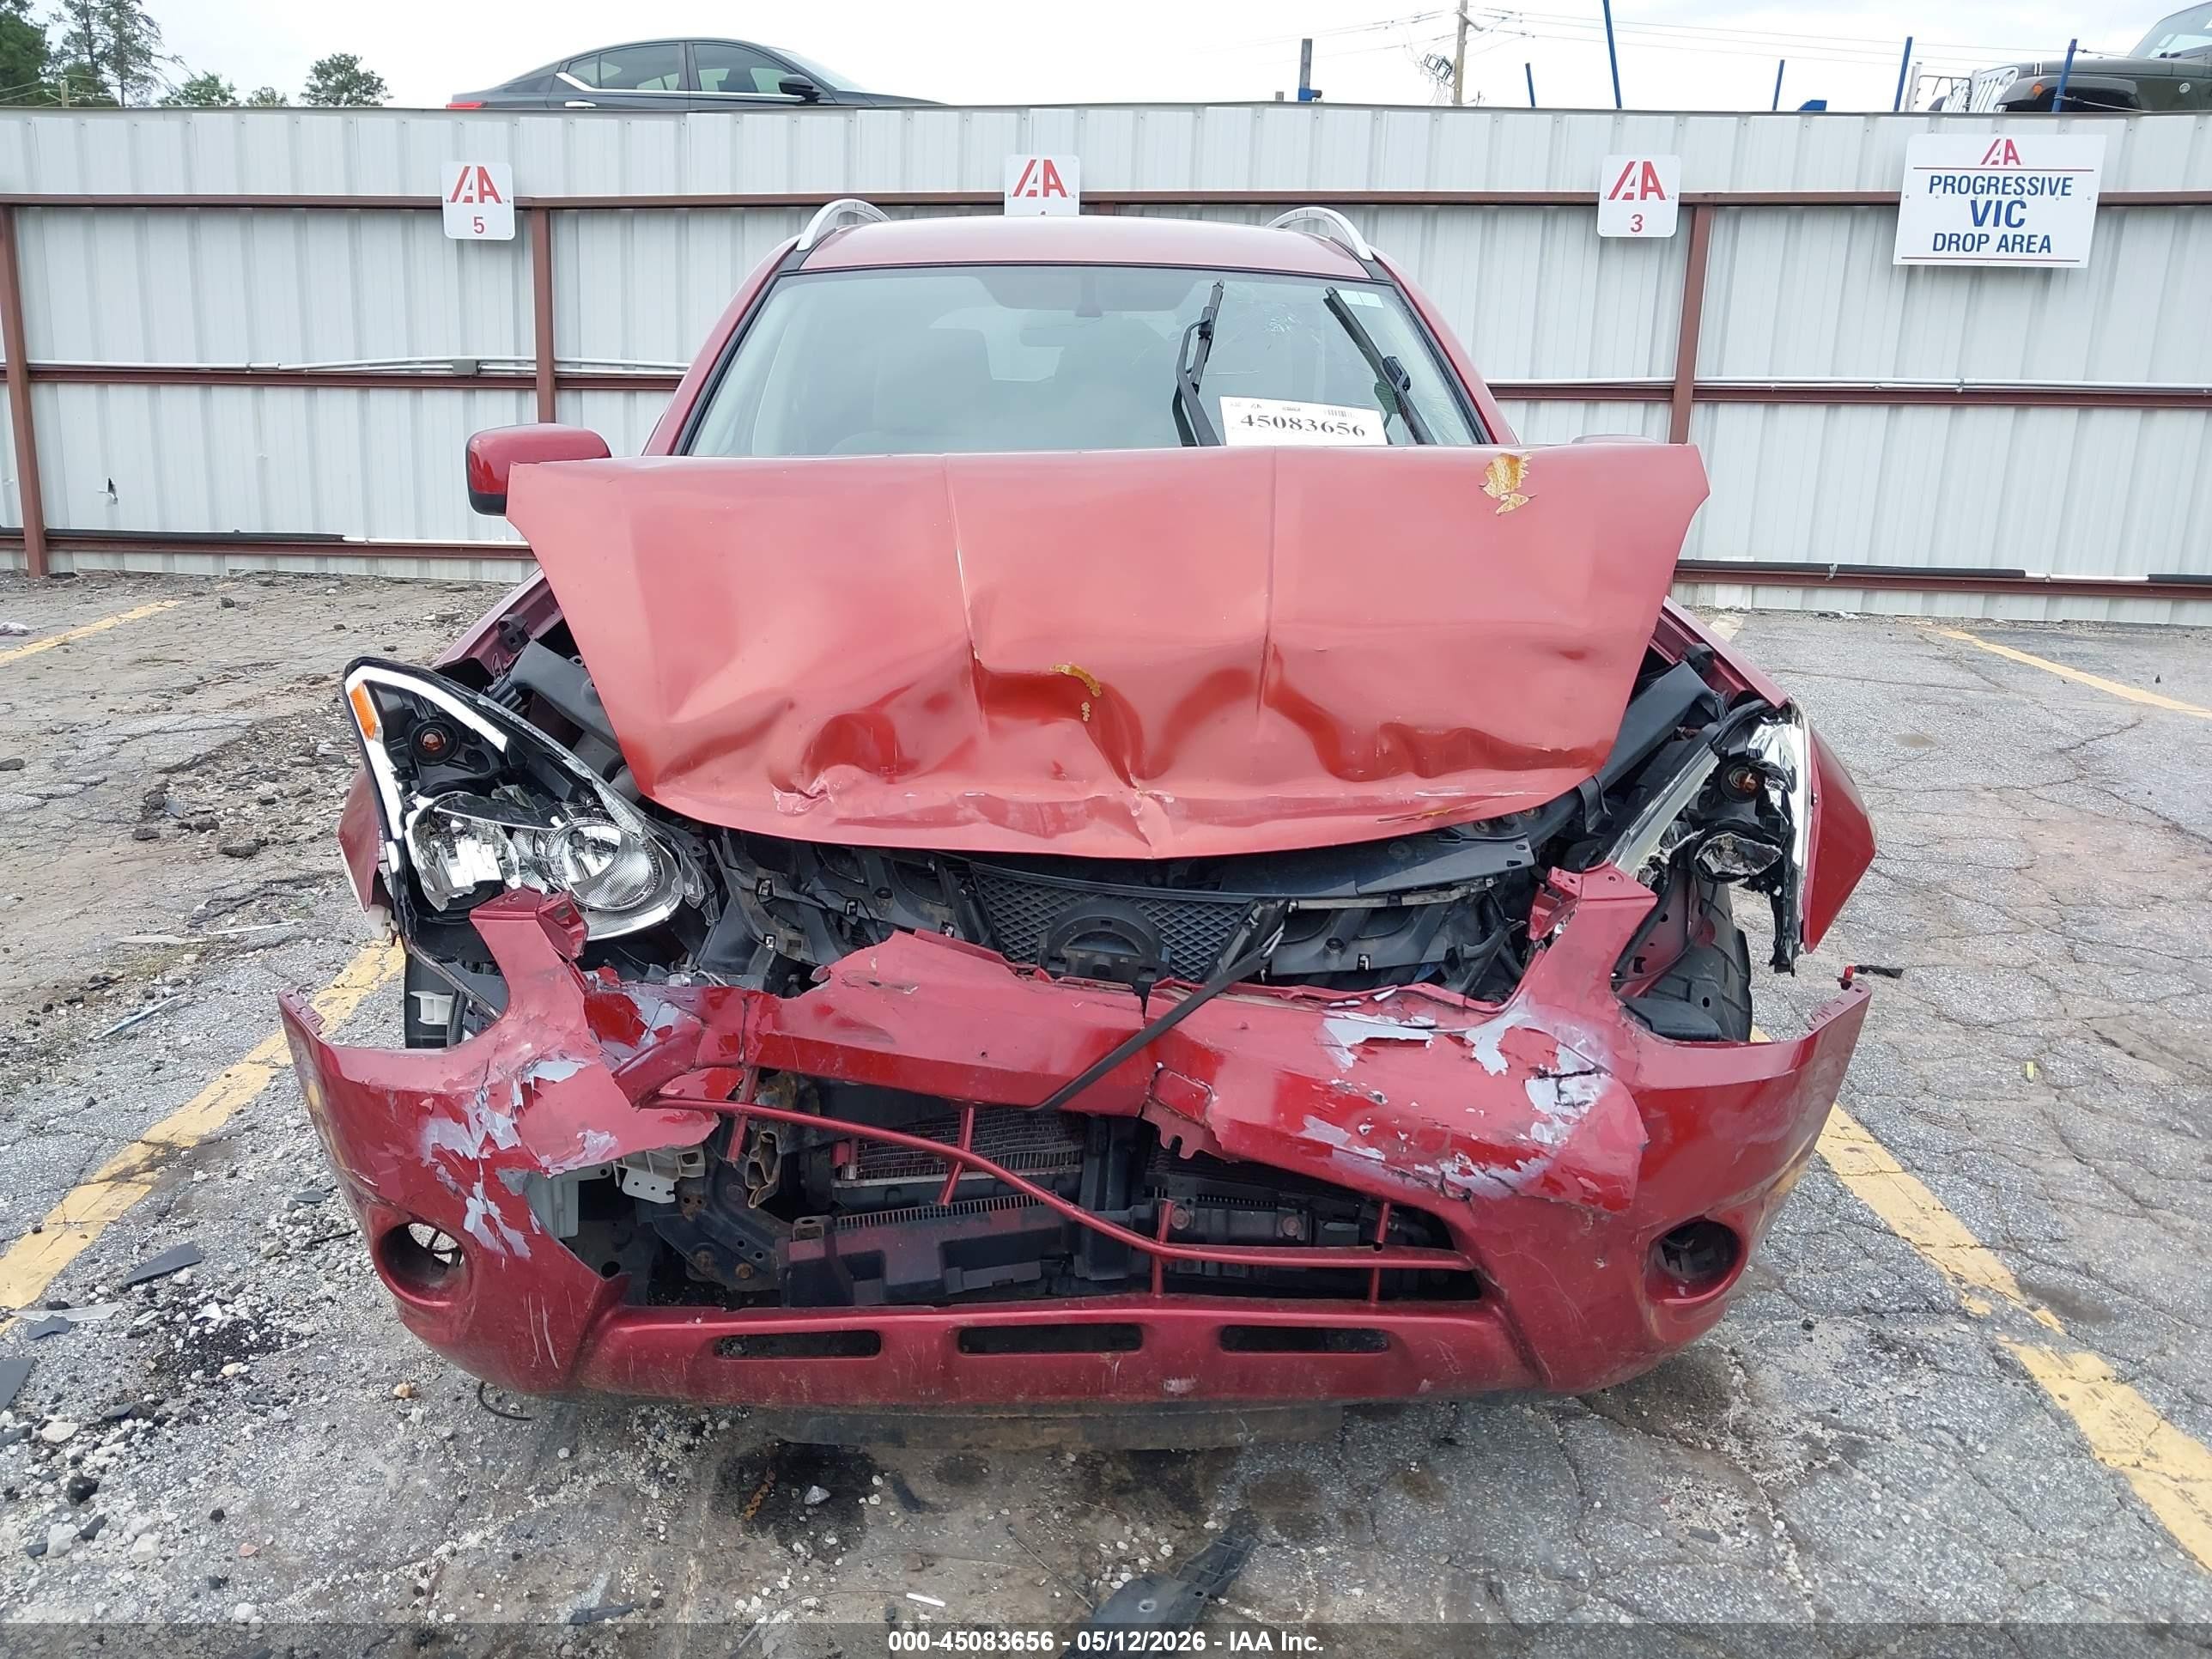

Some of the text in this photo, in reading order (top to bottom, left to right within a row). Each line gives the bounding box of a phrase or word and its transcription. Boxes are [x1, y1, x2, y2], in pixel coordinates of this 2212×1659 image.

[1929, 174, 2074, 197] PROGRESSIVE
[1630, 214, 1644, 233] 3
[1970, 199, 2027, 228] VIC
[473, 216, 485, 234] 5
[1932, 233, 2052, 253] DROP AREA
[1240, 414, 1365, 437] 45083656
